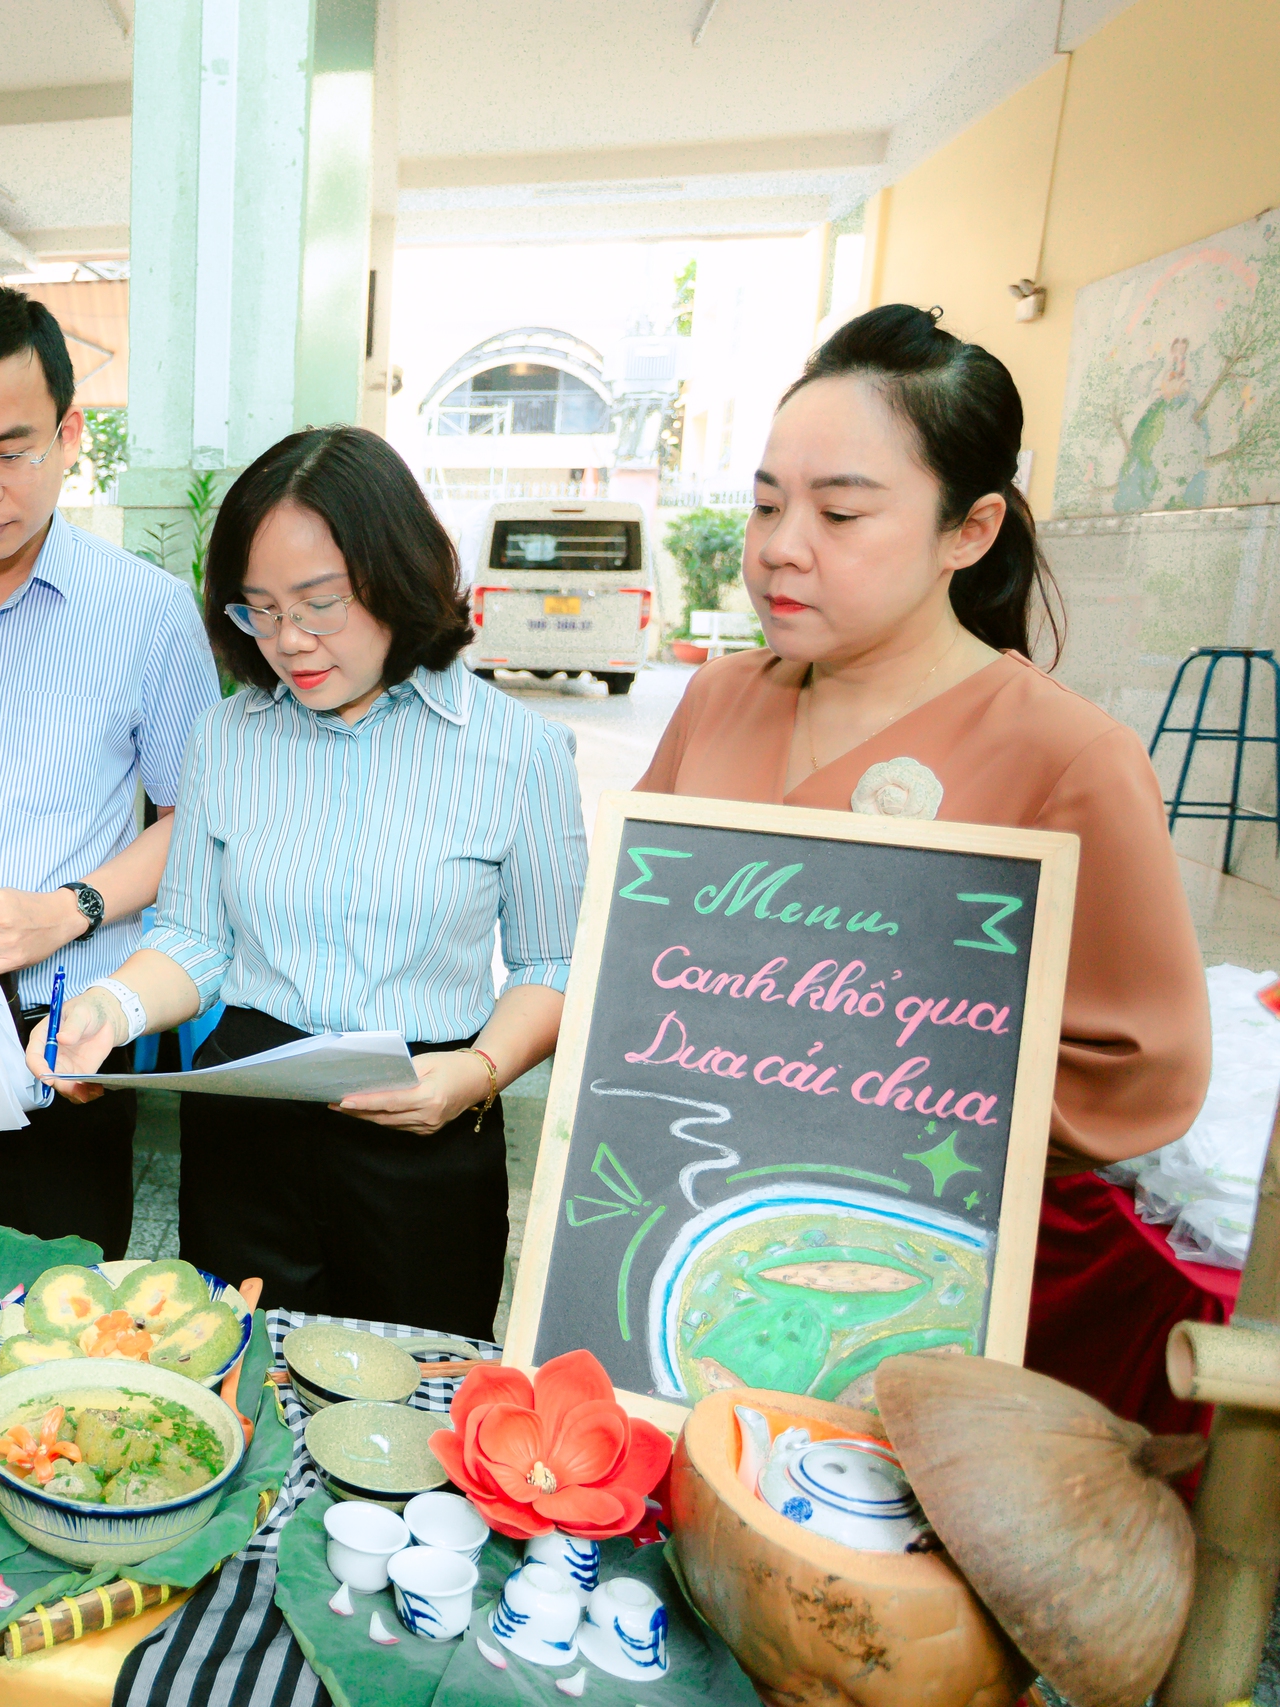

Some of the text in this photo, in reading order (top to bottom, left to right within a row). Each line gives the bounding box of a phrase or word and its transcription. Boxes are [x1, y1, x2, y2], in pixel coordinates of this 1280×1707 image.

[651, 945, 1011, 1048] Canh khổ qua
[624, 1010, 748, 1080] Dưa
[850, 1055, 999, 1127] chua
